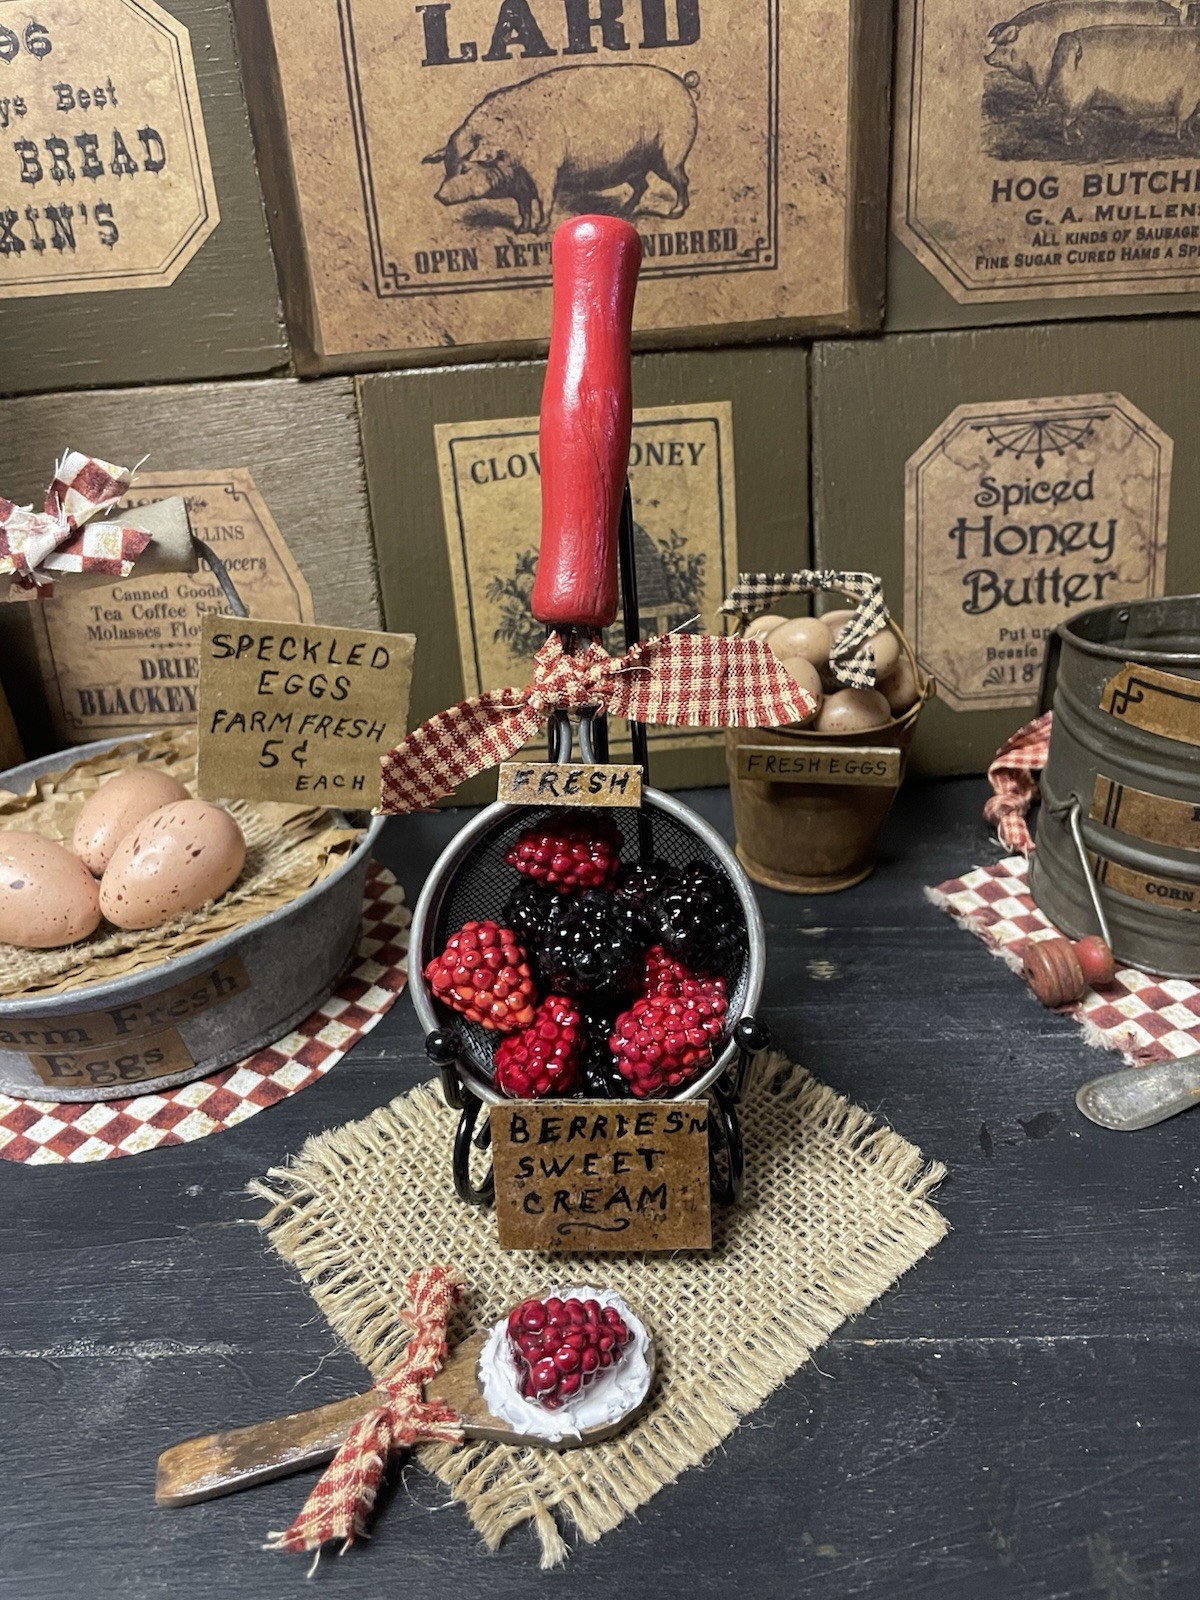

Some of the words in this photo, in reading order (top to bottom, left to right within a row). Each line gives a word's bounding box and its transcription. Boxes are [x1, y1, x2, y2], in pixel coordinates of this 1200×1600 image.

[416, 0, 700, 67] LARD
[53, 75, 118, 114] Best
[14, 124, 167, 188] BREAD
[991, 176, 1060, 203] HOG
[1060, 207, 1083, 223] A.
[1094, 203, 1200, 222] MULLEN
[1032, 231, 1060, 247] ALL
[1065, 230, 1108, 246] KINDS
[414, 247, 479, 274] OPEN
[975, 255, 1010, 270] FINE
[1014, 253, 1062, 268] SUGAR
[1066, 250, 1116, 265] CURED
[1121, 247, 1160, 261] HAMS
[1179, 243, 1200, 258] SP
[974, 469, 1095, 516] Spiced
[948, 515, 1118, 564] Honey
[112, 586, 169, 602] Canned
[177, 584, 224, 600] Goods
[962, 566, 1118, 615] Butter
[91, 604, 123, 621] Tea
[132, 602, 186, 620] Coffee
[87, 625, 162, 641] Molasses
[1000, 626, 1025, 642] Put
[211, 634, 390, 670] SPECKLED
[257, 670, 351, 701] EGGS
[210, 709, 294, 734] FARM
[298, 713, 387, 742] FRESH
[747, 755, 821, 773] FRESH
[829, 758, 888, 776] EGGS
[295, 774, 366, 791] EACH
[512, 769, 630, 797] FRESH
[1145, 882, 1195, 902] CORN
[105, 969, 240, 1036] Fresh
[40, 1046, 165, 1085] Eggs
[509, 1111, 684, 1144] BERRIES
[514, 1148, 665, 1179] SWEET
[522, 1182, 668, 1214] CREAM
